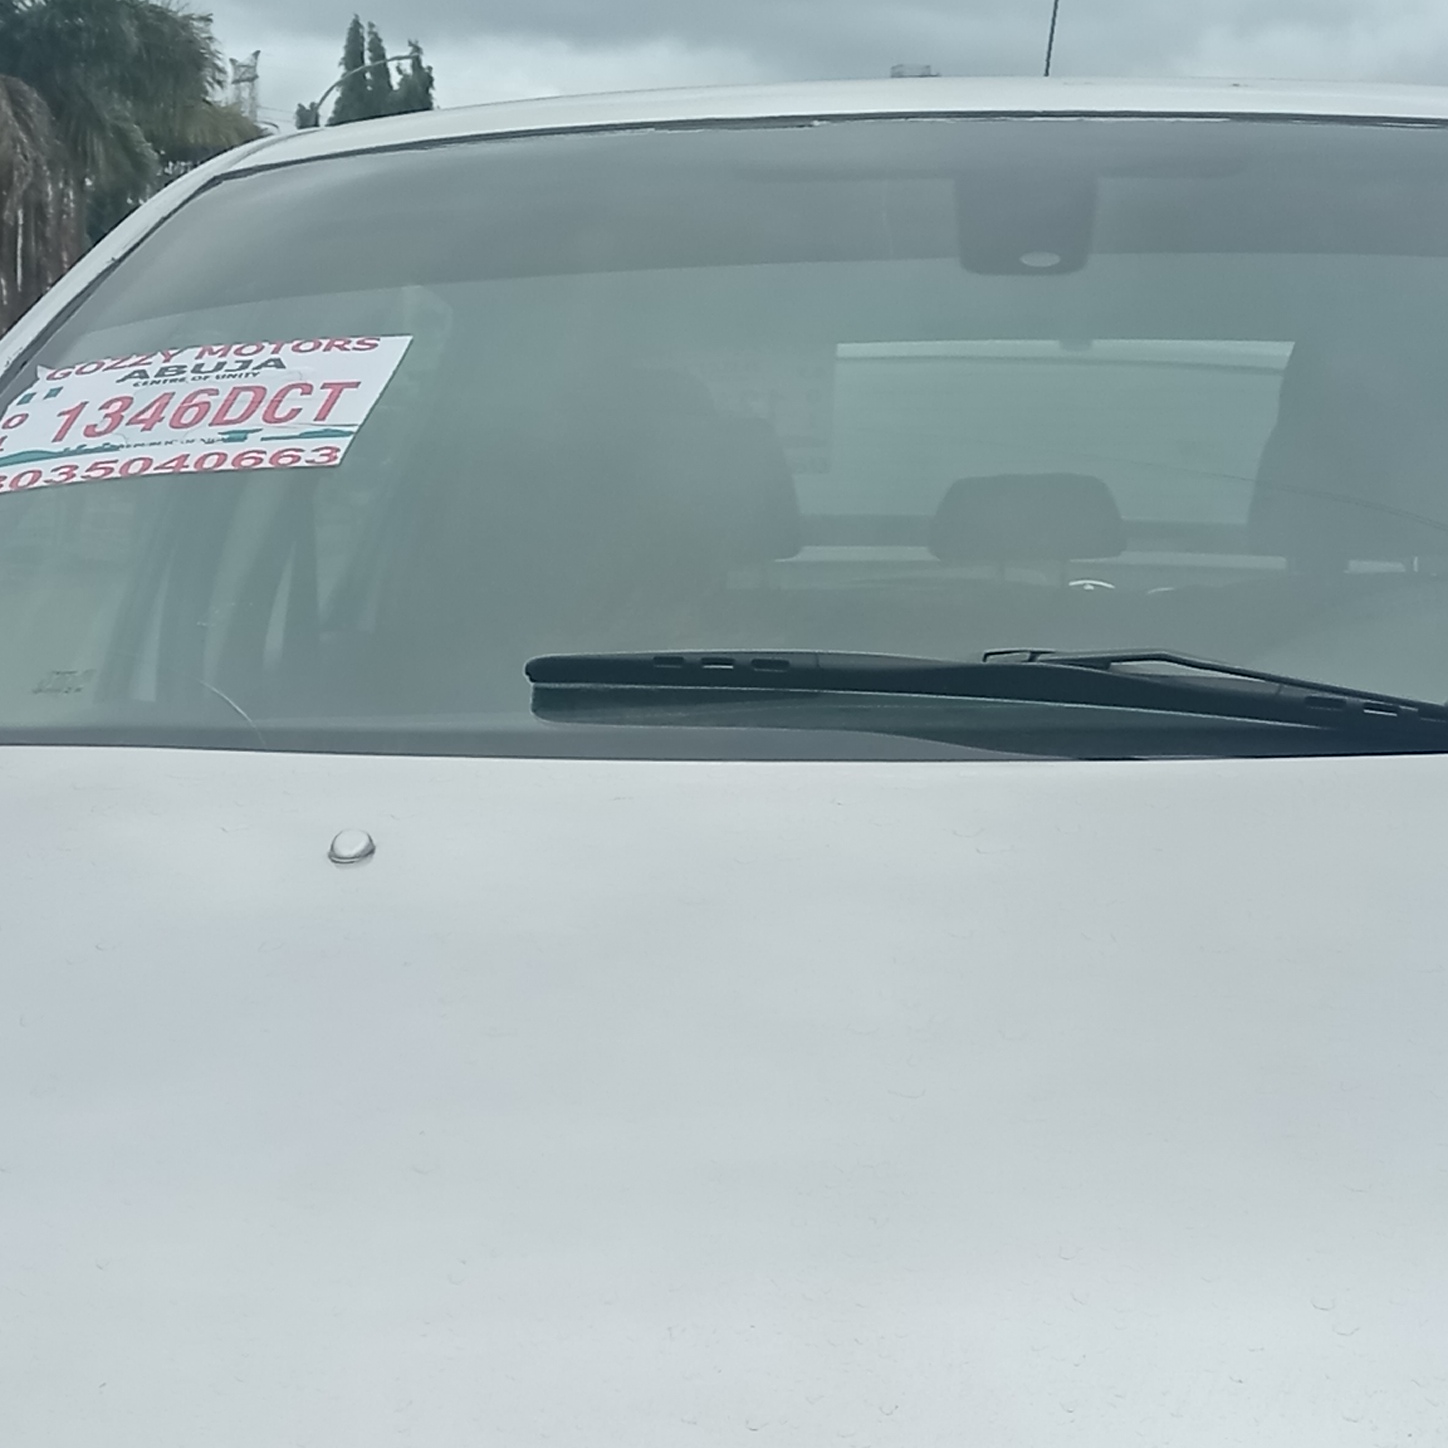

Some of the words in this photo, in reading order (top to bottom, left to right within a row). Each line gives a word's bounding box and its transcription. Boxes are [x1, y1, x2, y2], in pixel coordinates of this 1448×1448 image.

[45, 349, 181, 381] GOZZY
[194, 337, 381, 361] MOTORS
[115, 357, 287, 383] ABUJA
[132, 376, 186, 387] CENTRE
[191, 374, 211, 382] OF
[214, 371, 260, 381] UNITY
[51, 381, 361, 443] 1346DCT
